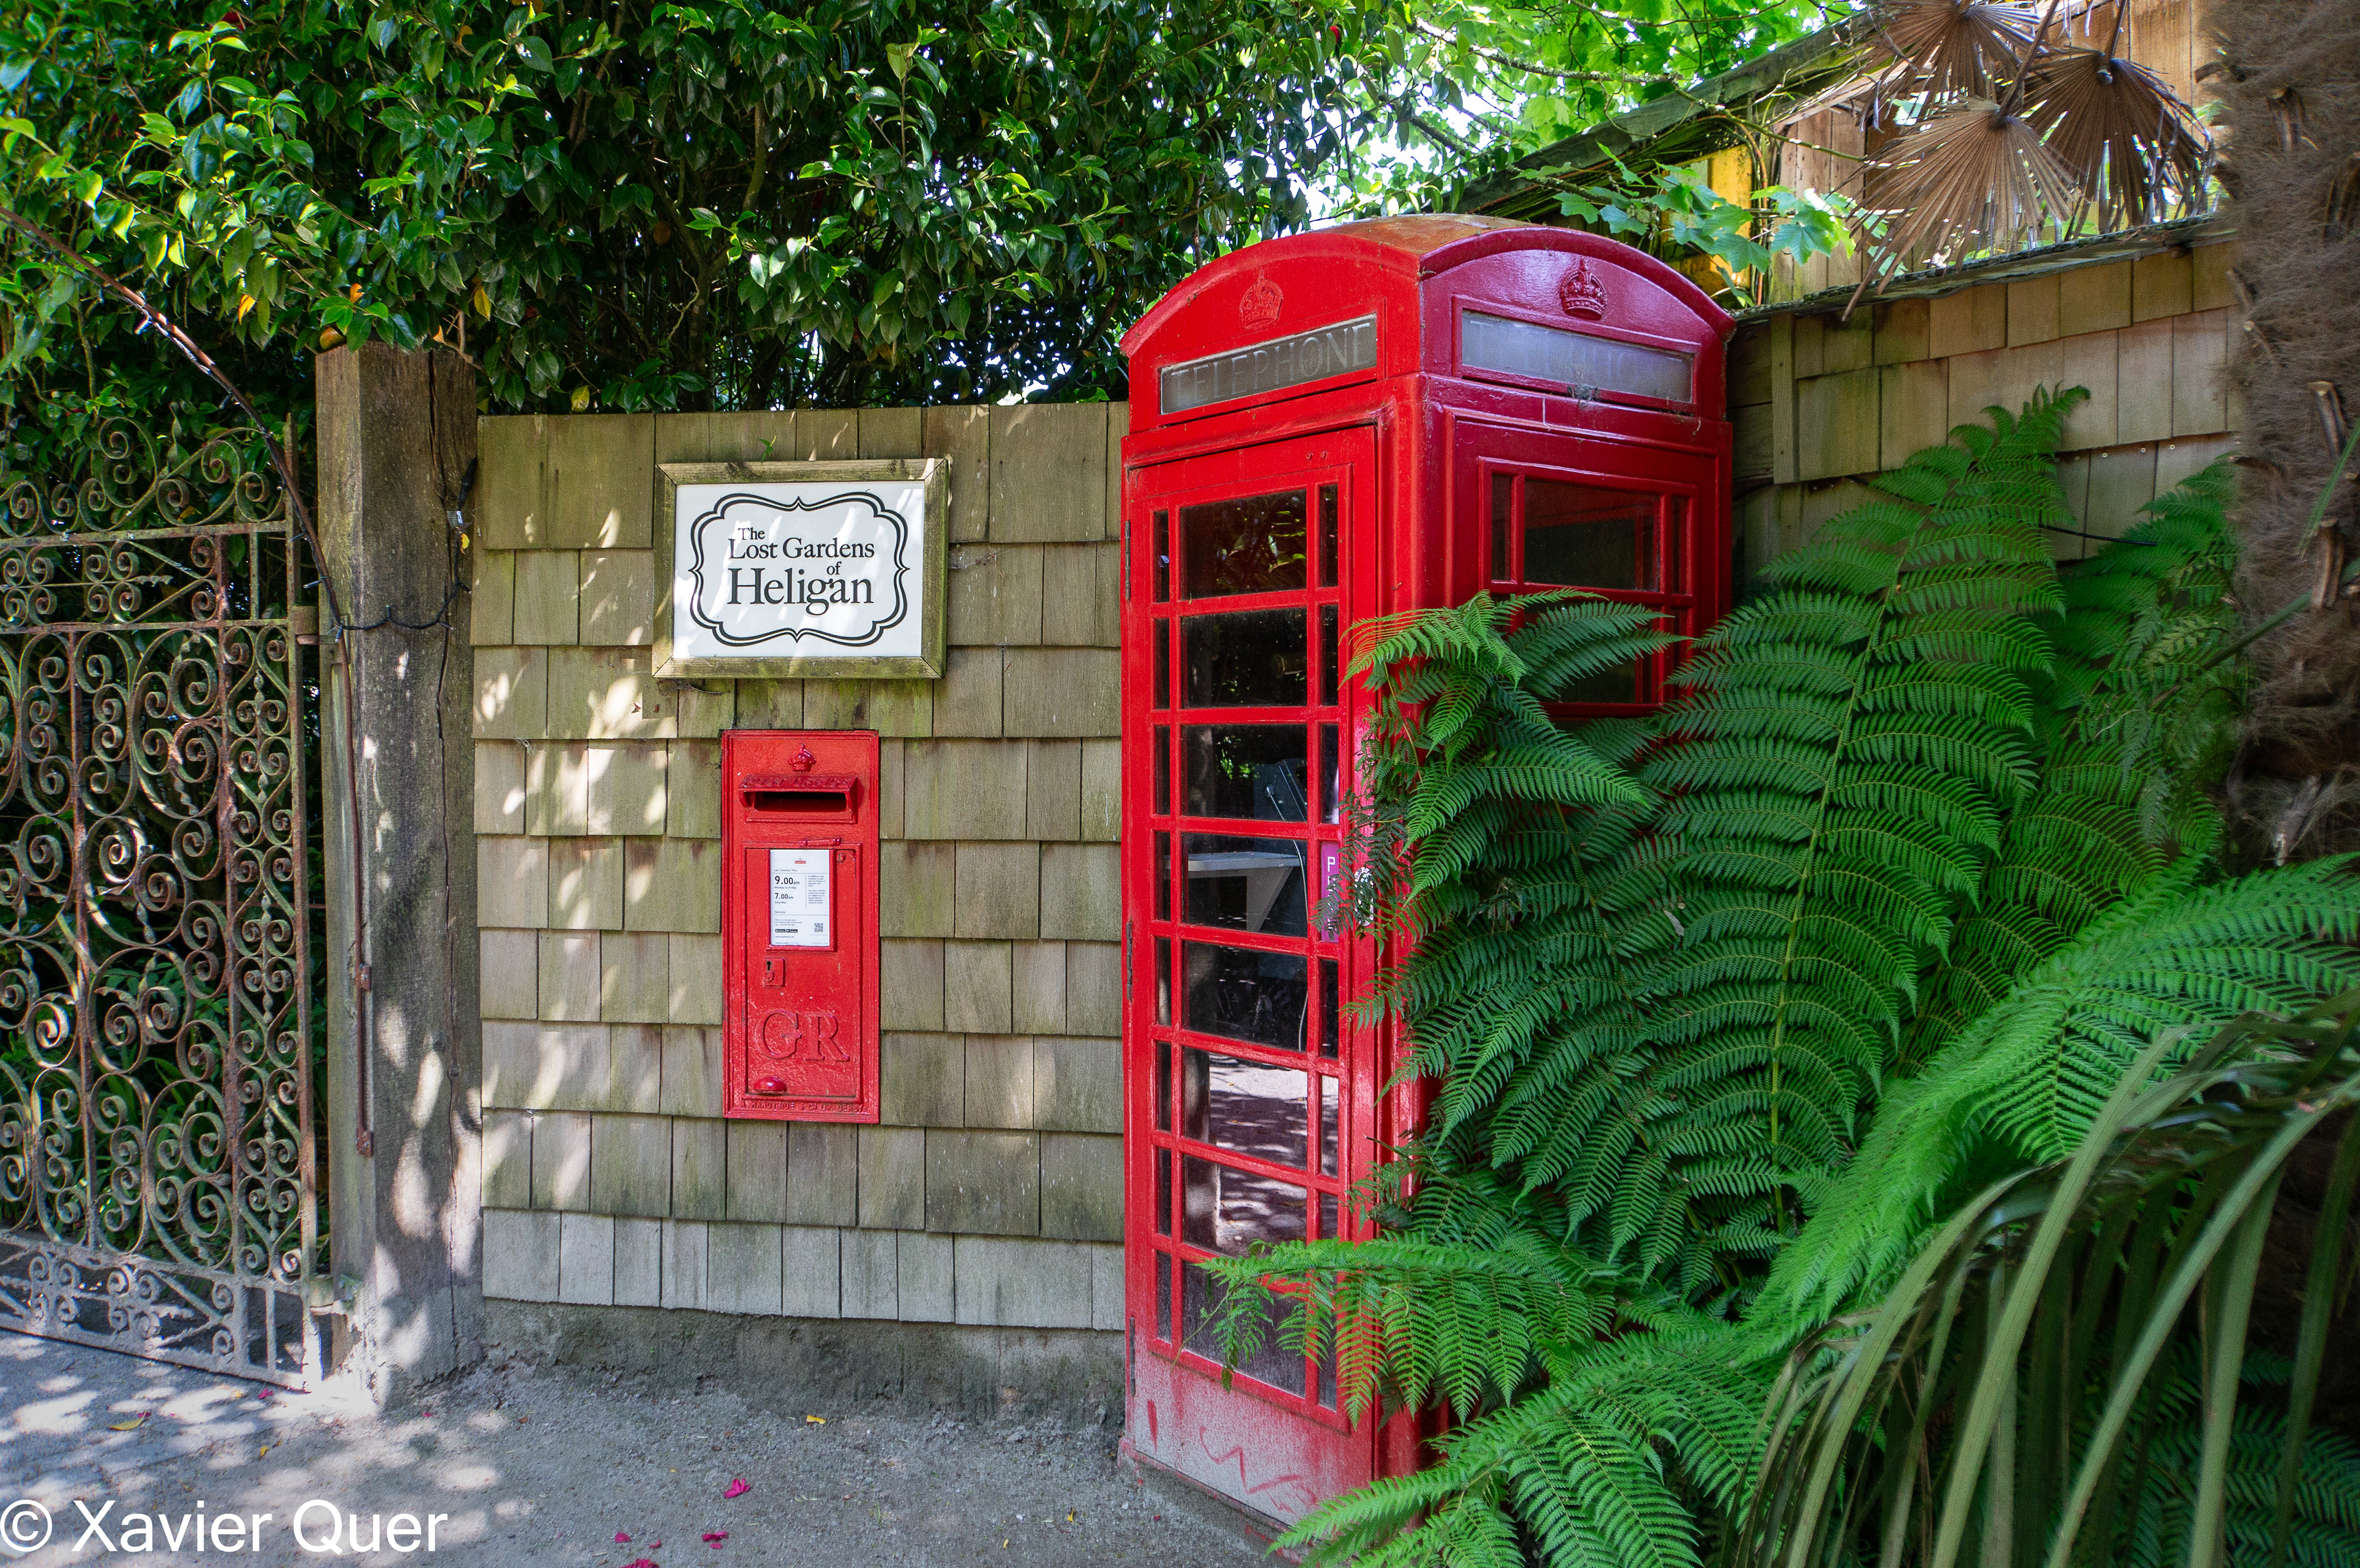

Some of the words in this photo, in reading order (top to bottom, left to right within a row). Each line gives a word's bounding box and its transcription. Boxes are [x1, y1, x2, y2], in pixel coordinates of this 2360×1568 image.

[1171, 323, 1371, 407] TELEPHONE
[728, 538, 777, 559] Lost
[782, 537, 875, 559] Gardens
[738, 527, 765, 540] The
[826, 561, 843, 575] of
[726, 568, 875, 616] Heligan
[753, 1009, 851, 1062] GR
